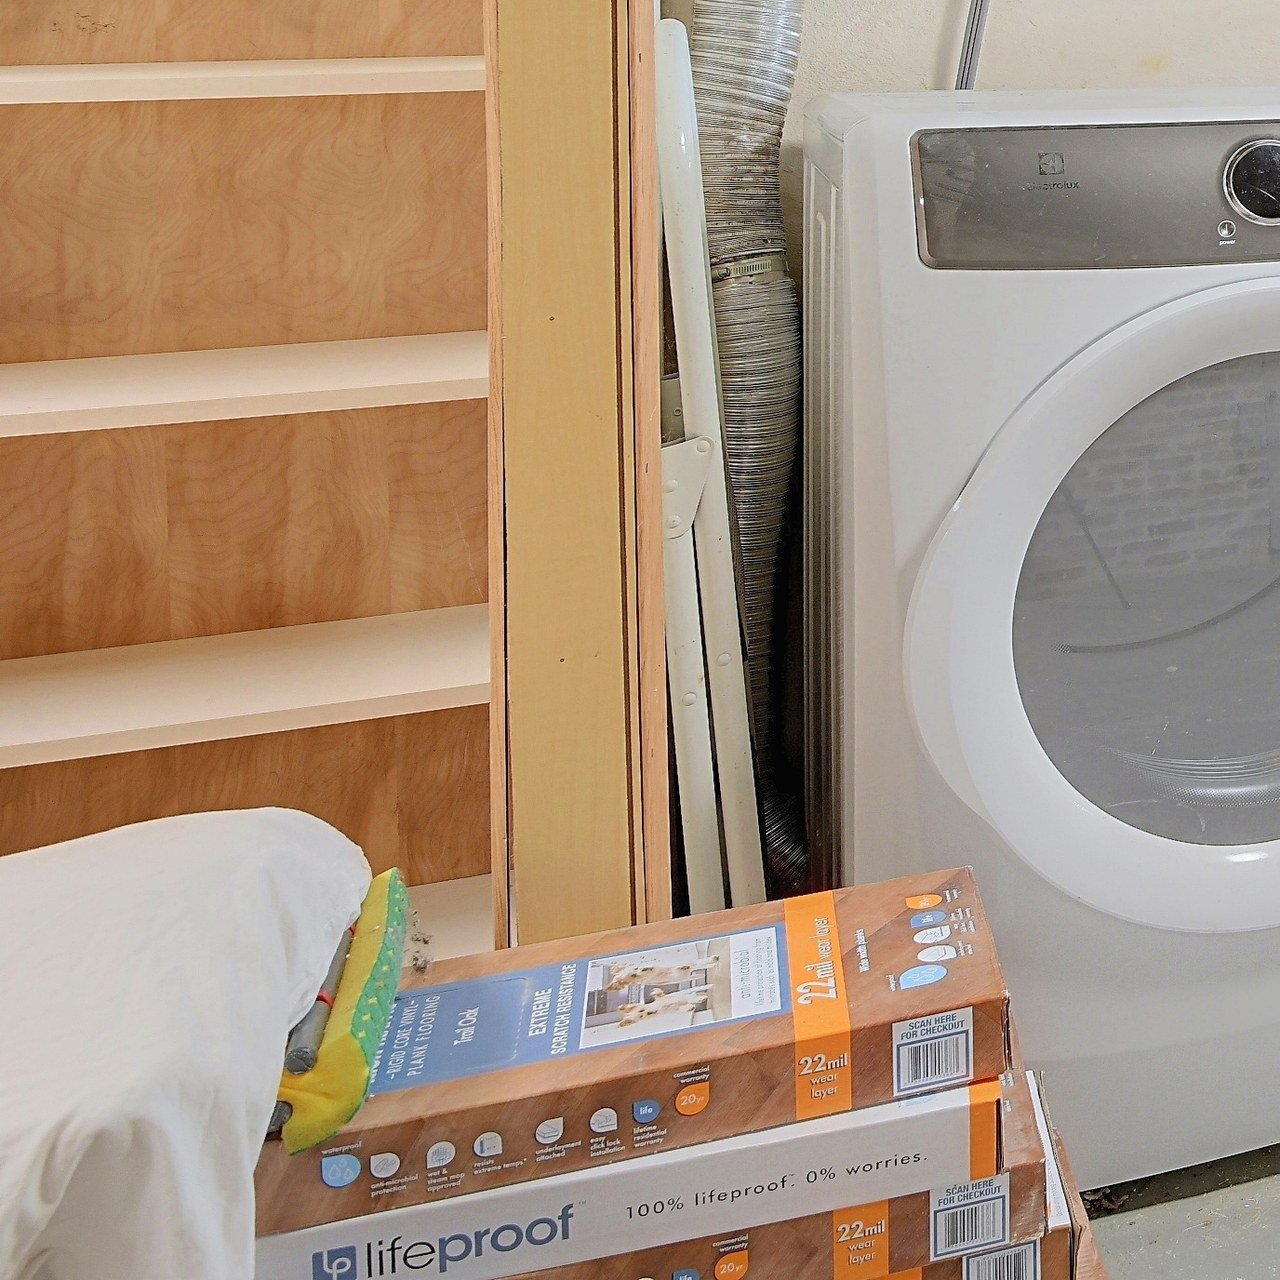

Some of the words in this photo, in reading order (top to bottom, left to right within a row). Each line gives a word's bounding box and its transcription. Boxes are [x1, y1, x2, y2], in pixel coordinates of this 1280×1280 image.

[809, 917, 835, 939] layer
[817, 939, 832, 960] wear
[558, 963, 576, 1014] RESISTANCE
[415, 995, 440, 1042] FLOORING
[458, 1006, 479, 1024] Oak
[528, 988, 552, 1037] EXTREME
[908, 1017, 933, 1031] SCAN
[934, 1012, 957, 1027] HERE
[393, 1027, 413, 1049] CORE
[453, 1023, 476, 1047] Trail
[551, 1013, 570, 1055] SCRATCH
[900, 1029, 918, 1041] FOR
[920, 1020, 965, 1038] CHECKOUT
[407, 1043, 429, 1077] PLANK
[799, 1052, 848, 1077] 22mil
[810, 1074, 837, 1086] wear
[810, 1086, 837, 1101] layer
[639, 1106, 653, 1115] life
[633, 1124, 658, 1135] lifetime
[633, 1128, 668, 1143] residential
[321, 1141, 362, 1156] waterproof
[535, 1140, 582, 1156] underlayment
[590, 1145, 626, 1158] installation
[611, 1138, 622, 1148] lock
[535, 1150, 567, 1163] attached
[449, 1172, 465, 1183] mop
[473, 1164, 502, 1176] extreme
[370, 1184, 408, 1198] protection
[427, 1180, 461, 1193] approved
[626, 1196, 685, 1221] 100%
[806, 1166, 836, 1184] 0%
[845, 1151, 929, 1177] worries.
[945, 1183, 970, 1197] SCAN
[971, 1178, 994, 1191] HERE
[938, 1195, 955, 1208] FOR
[957, 1185, 1002, 1203] CHECKOUT
[366, 1201, 575, 1278] lifeproof
[836, 1219, 885, 1244] 22mil
[848, 1239, 875, 1252] wear
[848, 1251, 876, 1266] layer
